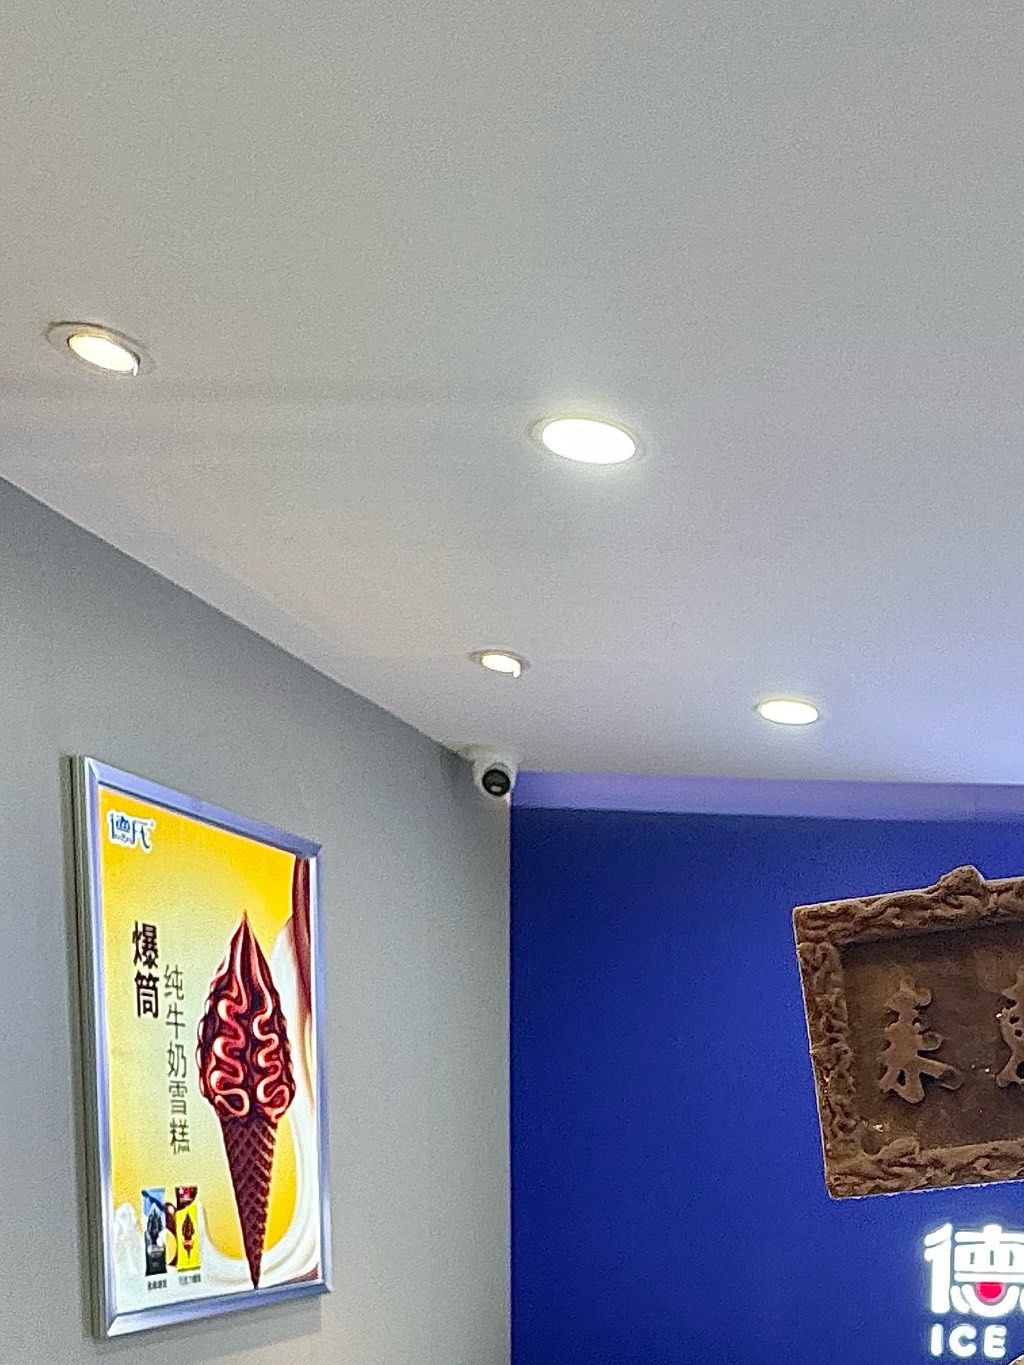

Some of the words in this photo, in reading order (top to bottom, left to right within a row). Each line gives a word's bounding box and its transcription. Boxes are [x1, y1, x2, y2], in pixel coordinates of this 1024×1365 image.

[132, 921, 160, 1018] 爆筒
[163, 963, 190, 1155] 纯牛奶雪糕
[931, 1323, 1007, 1358] ICE
